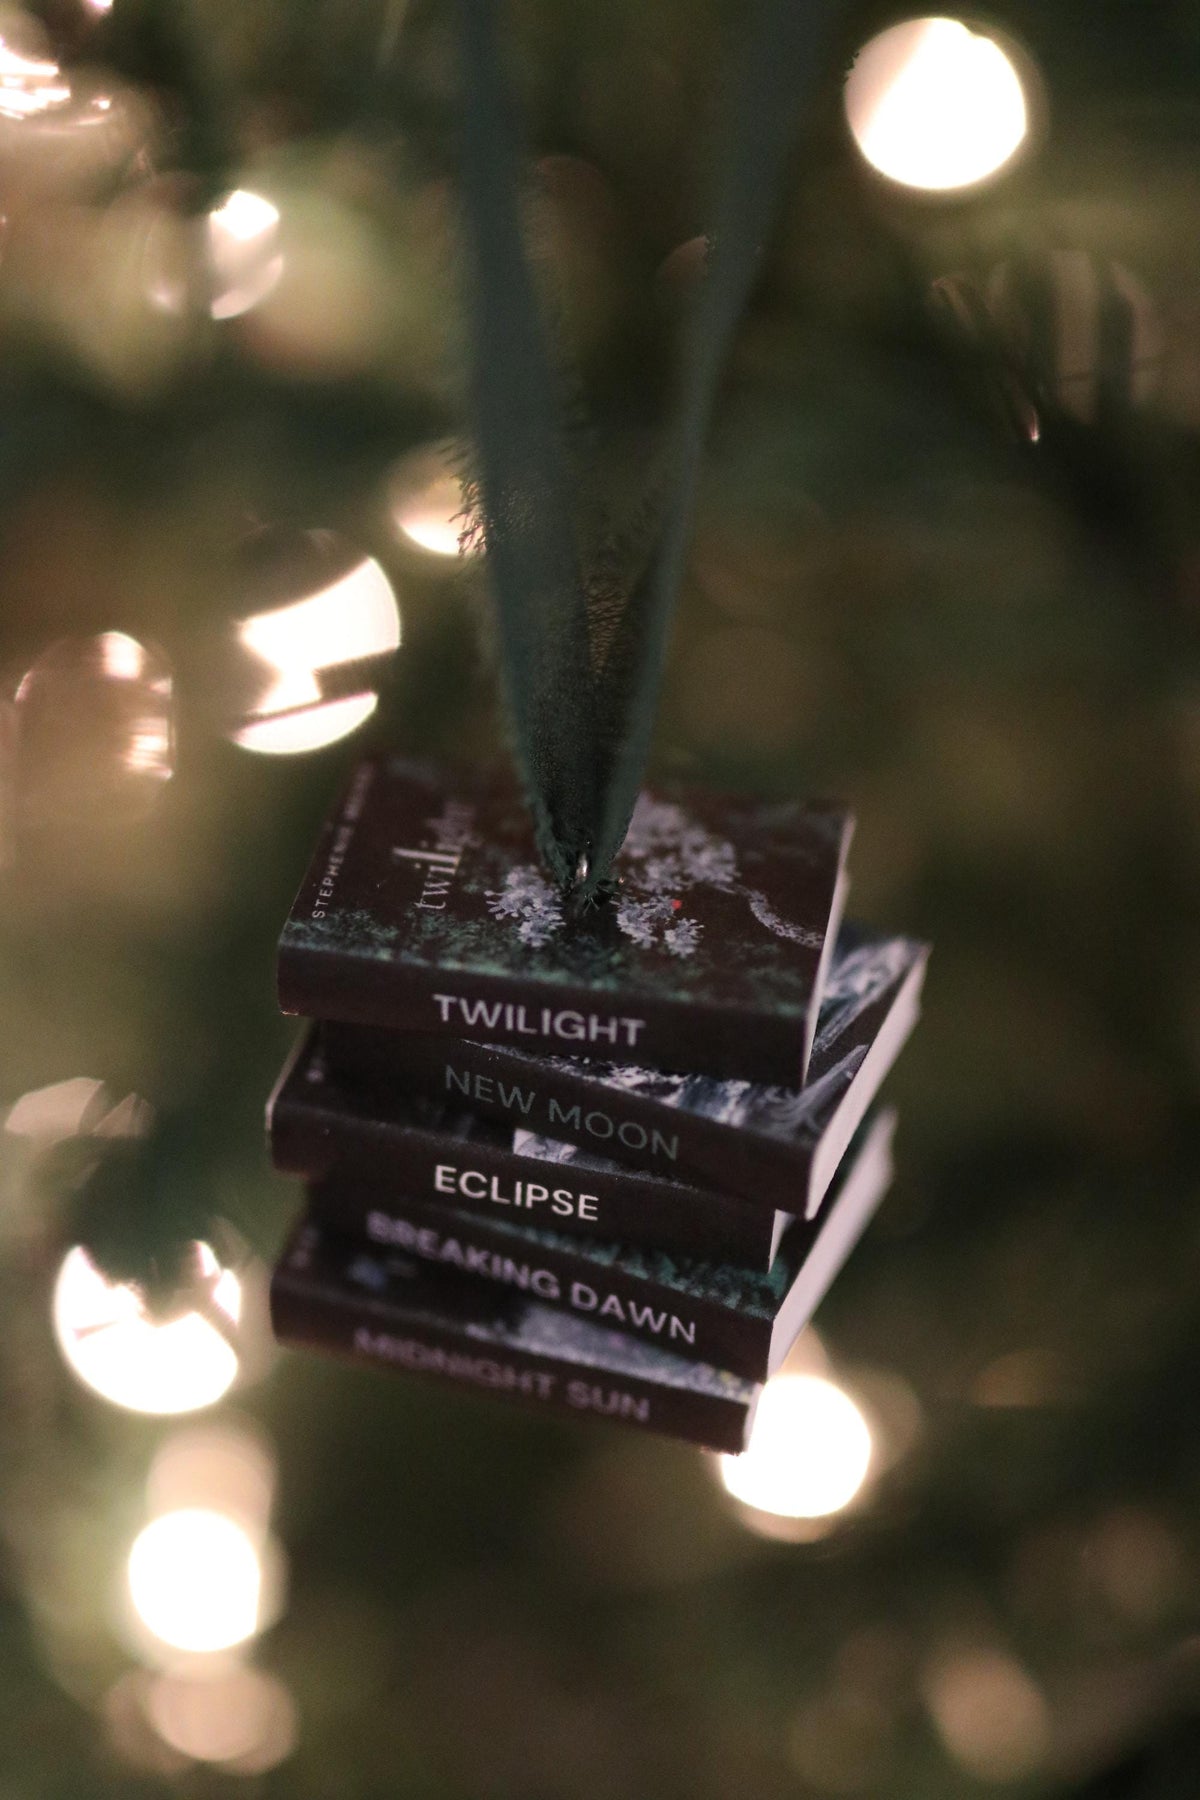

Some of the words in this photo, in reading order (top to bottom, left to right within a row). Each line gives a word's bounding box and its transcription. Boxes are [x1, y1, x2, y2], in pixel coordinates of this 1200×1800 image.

[312, 825, 352, 919] STEPHEN
[393, 800, 480, 910] twili
[433, 994, 646, 1046] TWILIGHT
[445, 1065, 536, 1114] NEW
[549, 1099, 679, 1160] MOON
[434, 1165, 599, 1221] ECLIPSE
[367, 1211, 560, 1298] BREAKING
[571, 1281, 696, 1344] DAWN
[567, 1380, 650, 1422] SUN
